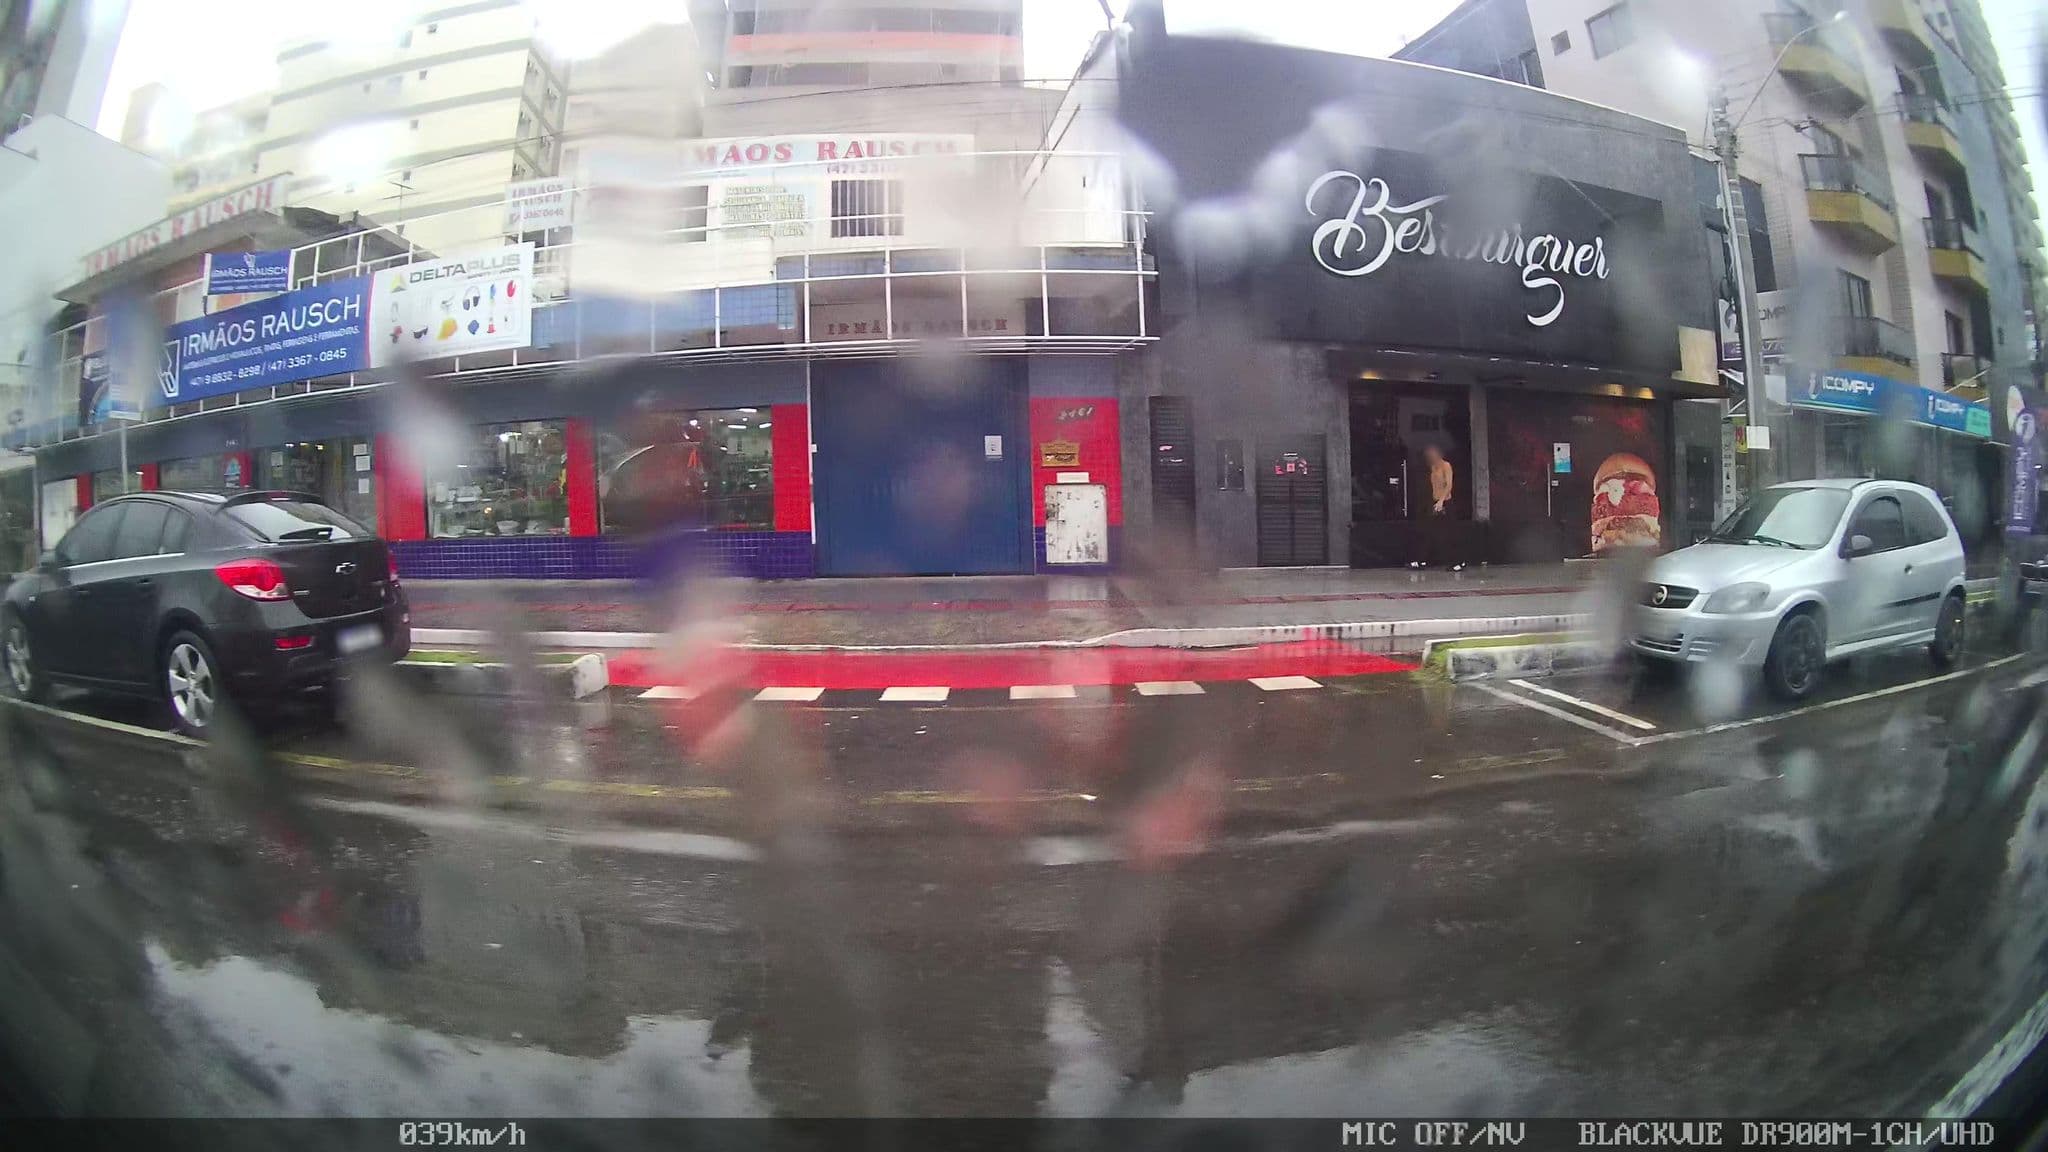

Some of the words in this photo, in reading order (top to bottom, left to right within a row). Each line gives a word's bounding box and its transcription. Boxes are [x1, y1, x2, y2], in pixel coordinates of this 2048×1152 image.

[183, 321, 256, 357] IRMÃOS
[261, 295, 361, 338] RAUSCH
[1822, 375, 1875, 396] ICOMPY
